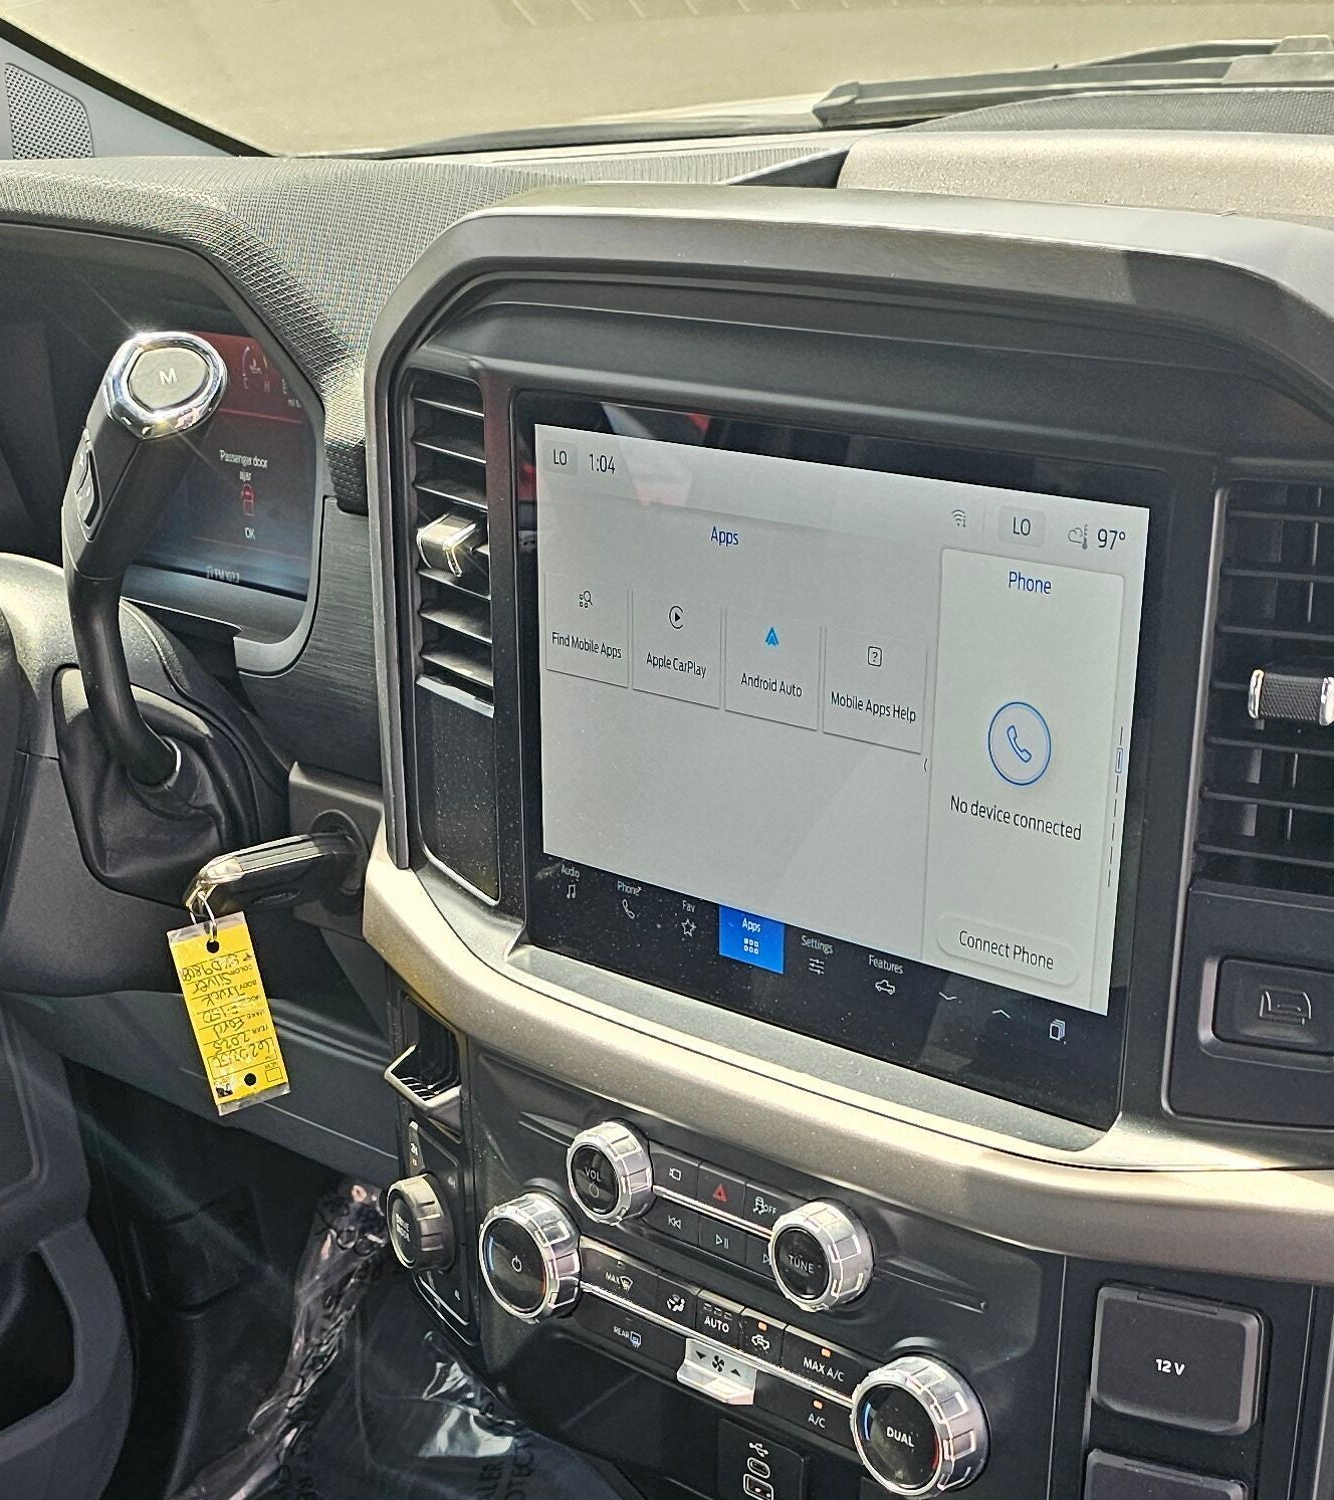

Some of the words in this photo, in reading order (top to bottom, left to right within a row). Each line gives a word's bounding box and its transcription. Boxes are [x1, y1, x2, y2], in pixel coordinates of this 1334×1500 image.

[159, 368, 178, 385] M
[219, 449, 252, 467] Passenger
[252, 455, 268, 469] door
[553, 448, 567, 466] LO
[589, 453, 616, 475] 1:04
[244, 527, 256, 541] OK
[710, 525, 739, 547] Apps
[1012, 516, 1032, 537] LO
[1097, 528, 1126, 550] 97°
[1008, 570, 1052, 595] Phone
[552, 631, 570, 647] Find
[571, 635, 599, 654] Mobile
[600, 642, 622, 660] Apps
[646, 652, 672, 669] Apple
[672, 657, 707, 679] CarPlay
[740, 672, 777, 693] Android
[779, 681, 803, 698] Auto
[831, 691, 864, 711] Mobile
[865, 699, 891, 718] Apps
[892, 704, 916, 724] Help
[950, 795, 968, 814] No
[970, 800, 1011, 824] device
[1013, 812, 1082, 841] connected
[561, 864, 580, 879] Audio
[617, 880, 641, 897] Phone
[682, 900, 696, 913] Fav
[742, 917, 761, 933] Apps
[801, 934, 834, 955] Settings
[959, 930, 1010, 959] Connect
[1013, 944, 1054, 970] Phone
[868, 954, 904, 975] Features
[190, 973, 232, 995] Silver
[200, 985, 246, 1007] Truck
[212, 1017, 246, 1039] Ford
[212, 1031, 251, 1054] 2025
[584, 1166, 602, 1182] VOL
[764, 1204, 777, 1215] OFF
[788, 1254, 815, 1274] TUNE
[605, 1271, 620, 1284] MAX
[613, 1325, 630, 1338] REAR
[703, 1316, 729, 1333] AUTO
[803, 1356, 825, 1376] MAX
[826, 1365, 844, 1383] A/C
[1155, 1358, 1170, 1374] 12
[1174, 1362, 1185, 1375] V
[807, 1412, 826, 1429] A/C
[886, 1426, 914, 1448] DUAL
